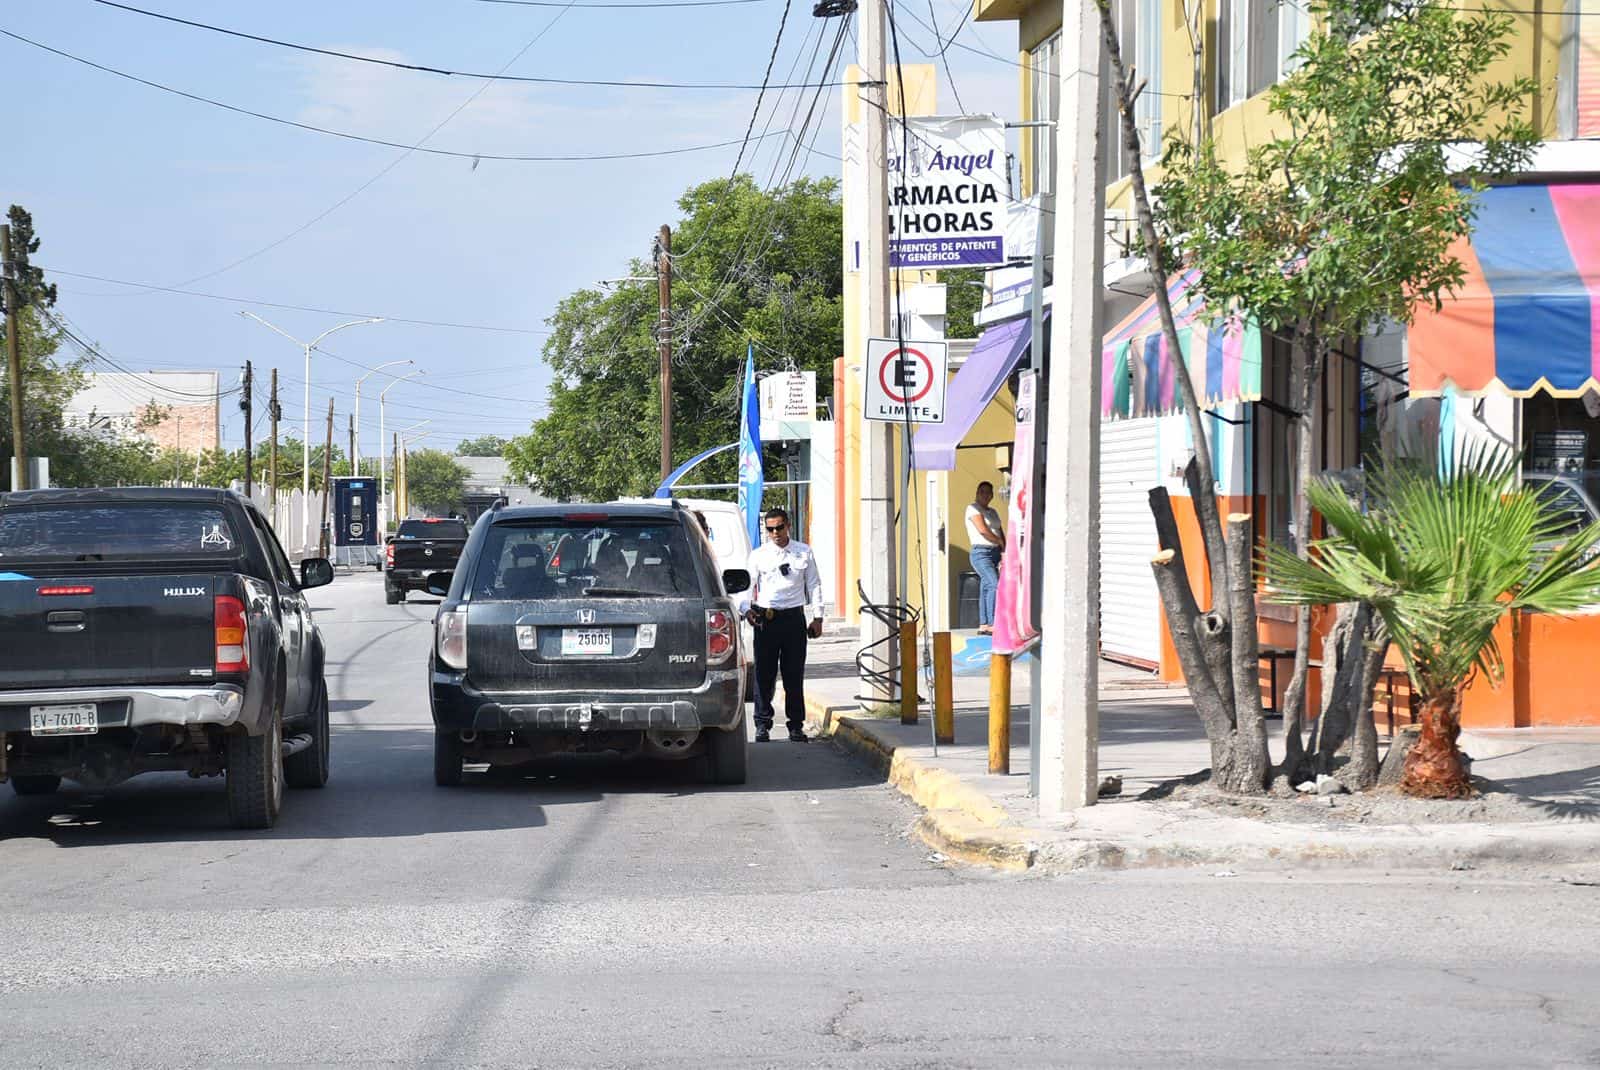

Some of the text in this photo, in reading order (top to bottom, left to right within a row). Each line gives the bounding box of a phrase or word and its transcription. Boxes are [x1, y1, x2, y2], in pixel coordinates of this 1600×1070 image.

[928, 145, 994, 176] Ángel
[904, 211, 993, 233] HORAS
[941, 242, 953, 251] DE
[955, 240, 997, 250] PATENTE
[908, 251, 960, 261] GENÉRICOS
[895, 360, 916, 387] E
[880, 405, 930, 416] LIMTE
[163, 587, 206, 596] HILUX
[578, 632, 611, 646] 25005
[668, 654, 699, 664] PILOT
[33, 711, 95, 728] EV-7670-B
